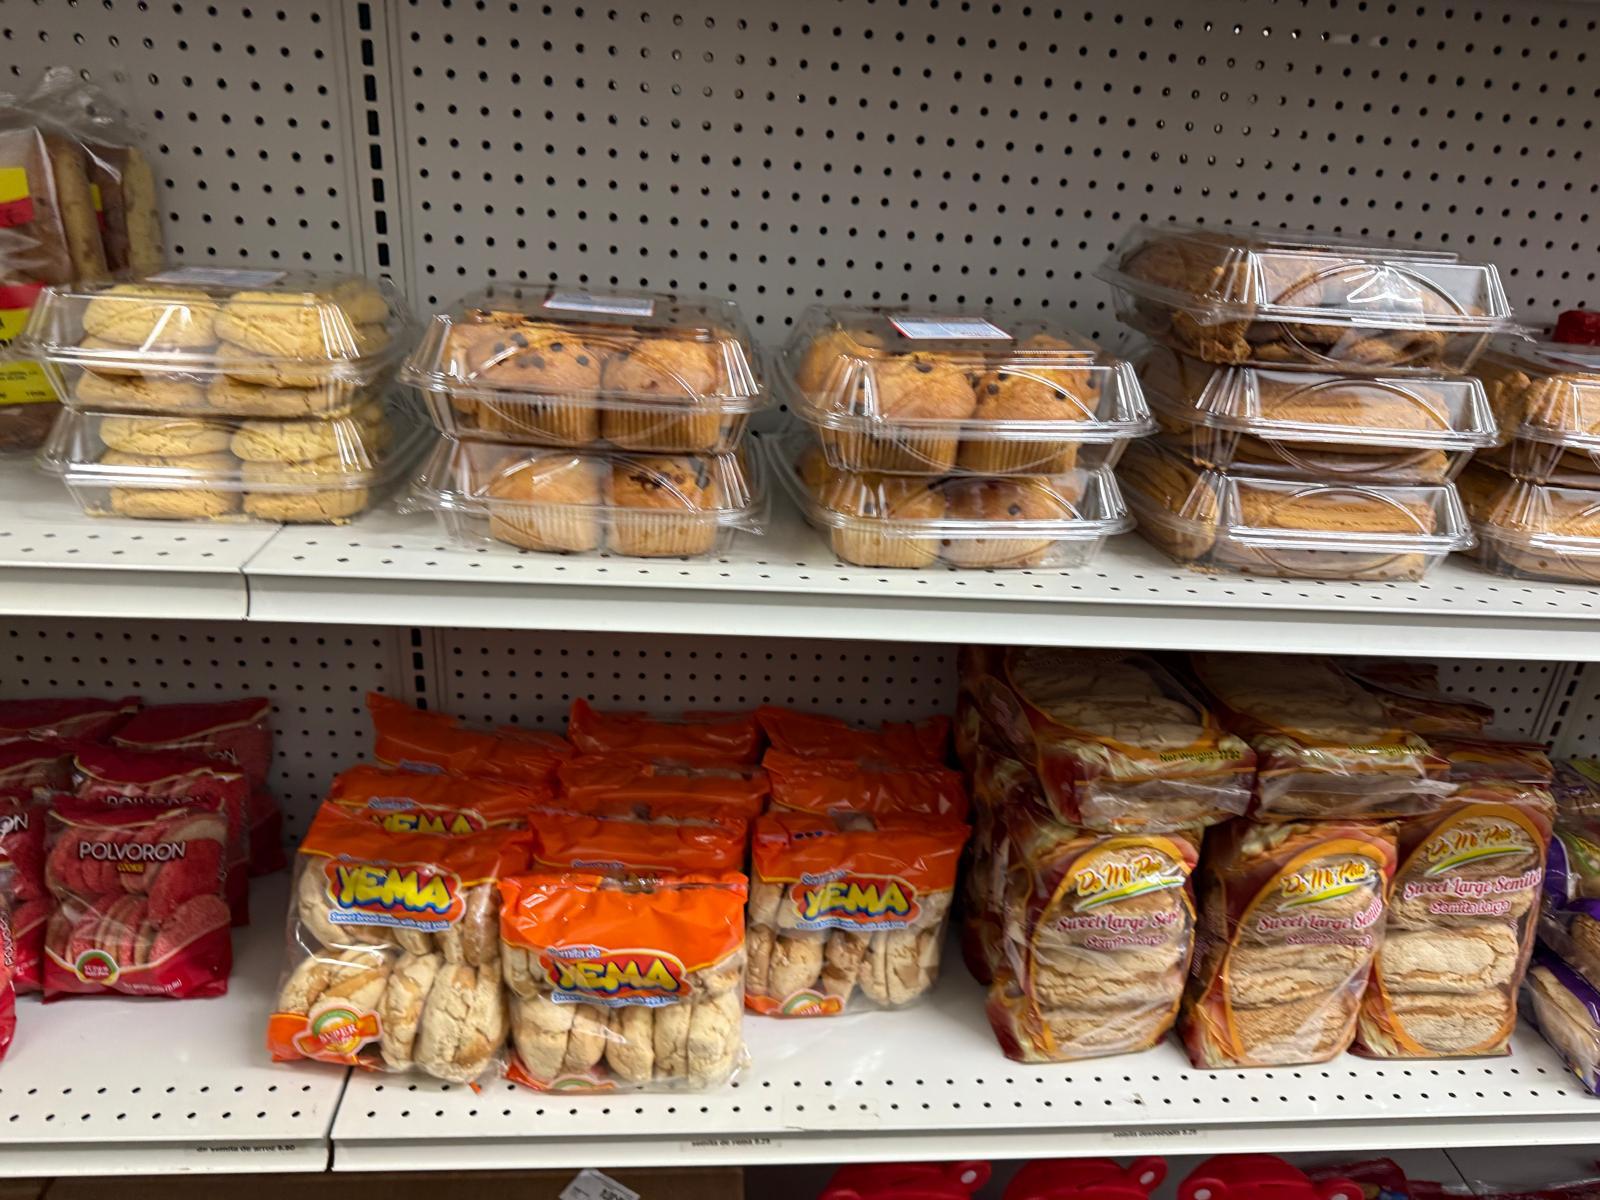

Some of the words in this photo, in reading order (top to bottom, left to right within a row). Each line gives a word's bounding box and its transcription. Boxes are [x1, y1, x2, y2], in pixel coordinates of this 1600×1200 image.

[79, 840, 186, 861] POLVORON
[336, 864, 453, 915] YEMA
[1403, 880, 1448, 900] Sweet
[1451, 877, 1492, 899] Large
[803, 880, 911, 921] YEMA
[1430, 901, 1476, 915] Semita
[1057, 913, 1101, 932] Sweet
[1104, 912, 1147, 934] Large
[1256, 915, 1304, 932] Sweet
[552, 957, 681, 995] YEMA
